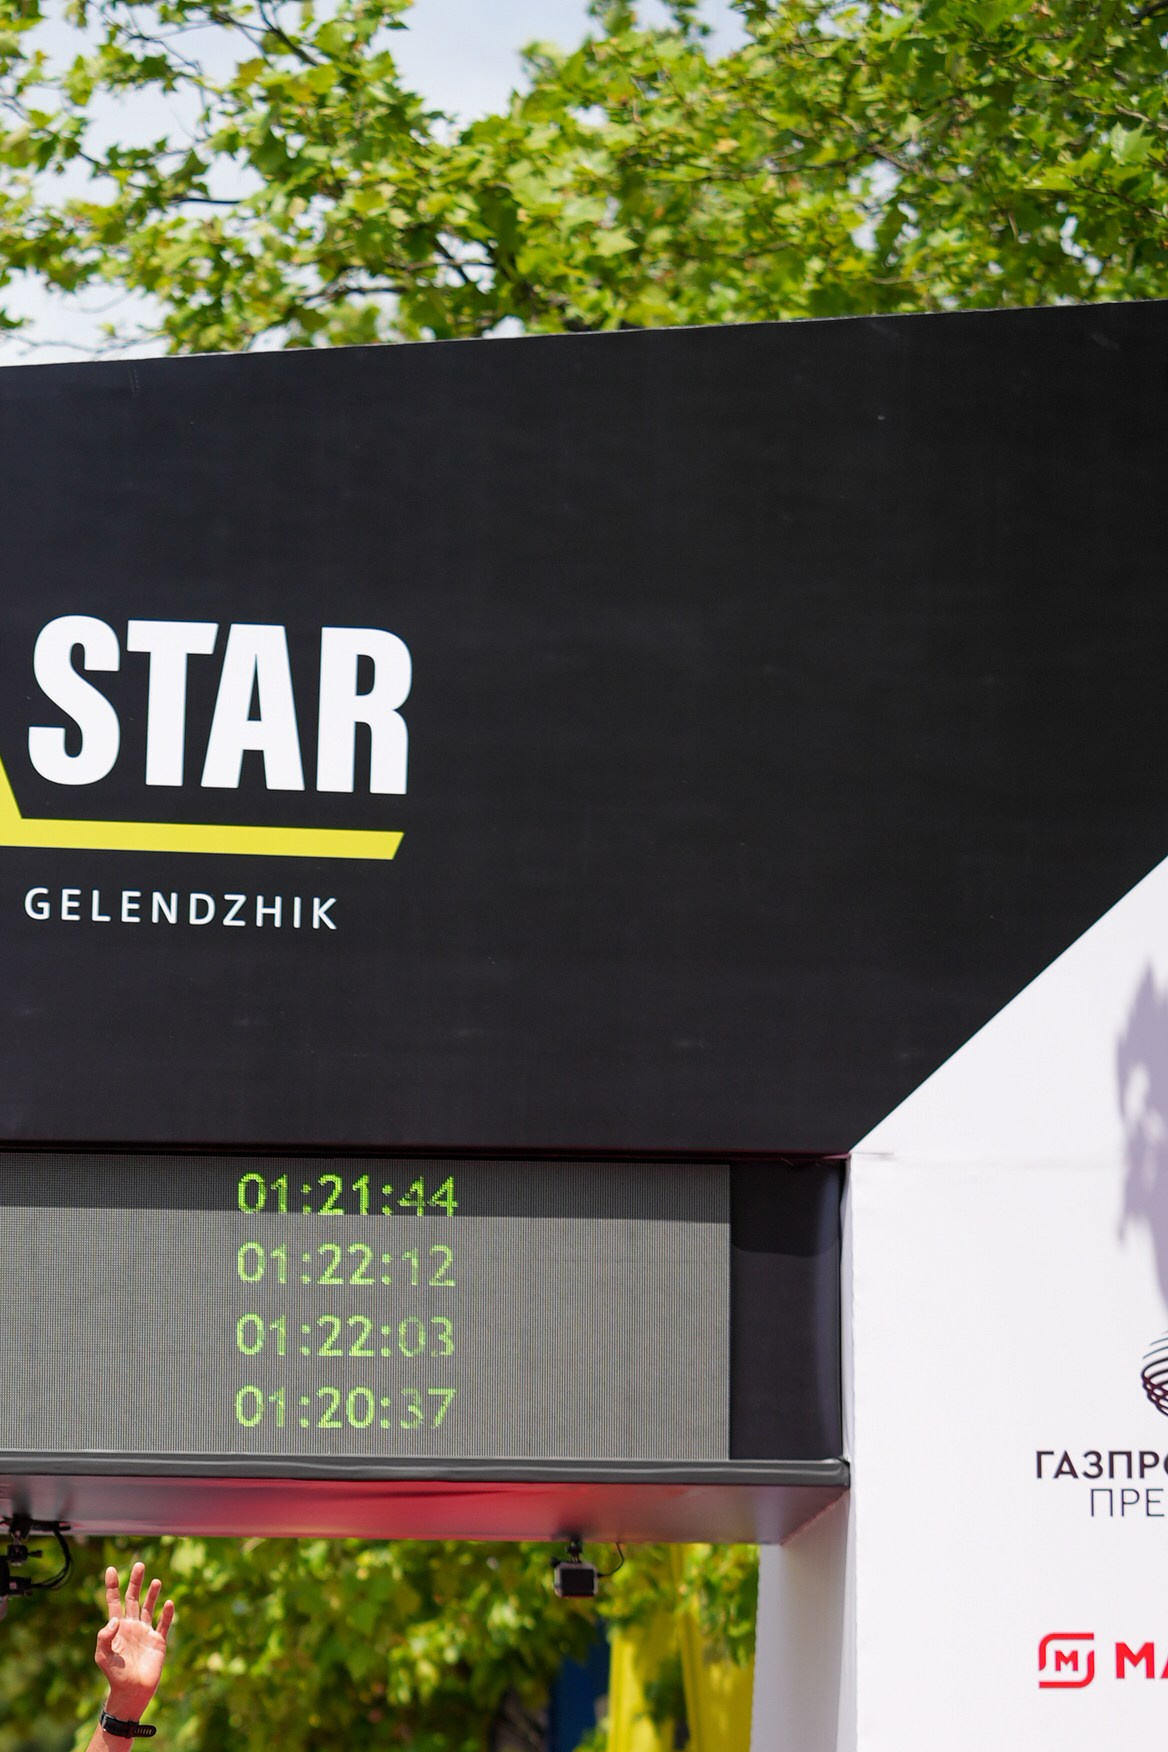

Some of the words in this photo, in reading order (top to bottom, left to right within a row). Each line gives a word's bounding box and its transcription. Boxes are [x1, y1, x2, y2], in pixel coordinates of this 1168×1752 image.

[28, 615, 412, 795] STAR
[24, 887, 339, 930] GELENDZHIK
[236, 1172, 459, 1217] 01:21:44
[236, 1242, 457, 1287] 01:22:12
[235, 1313, 456, 1358] 01:22:03
[234, 1385, 458, 1429] 01:20:37
[1036, 1450, 1168, 1479] ГАЗПР
